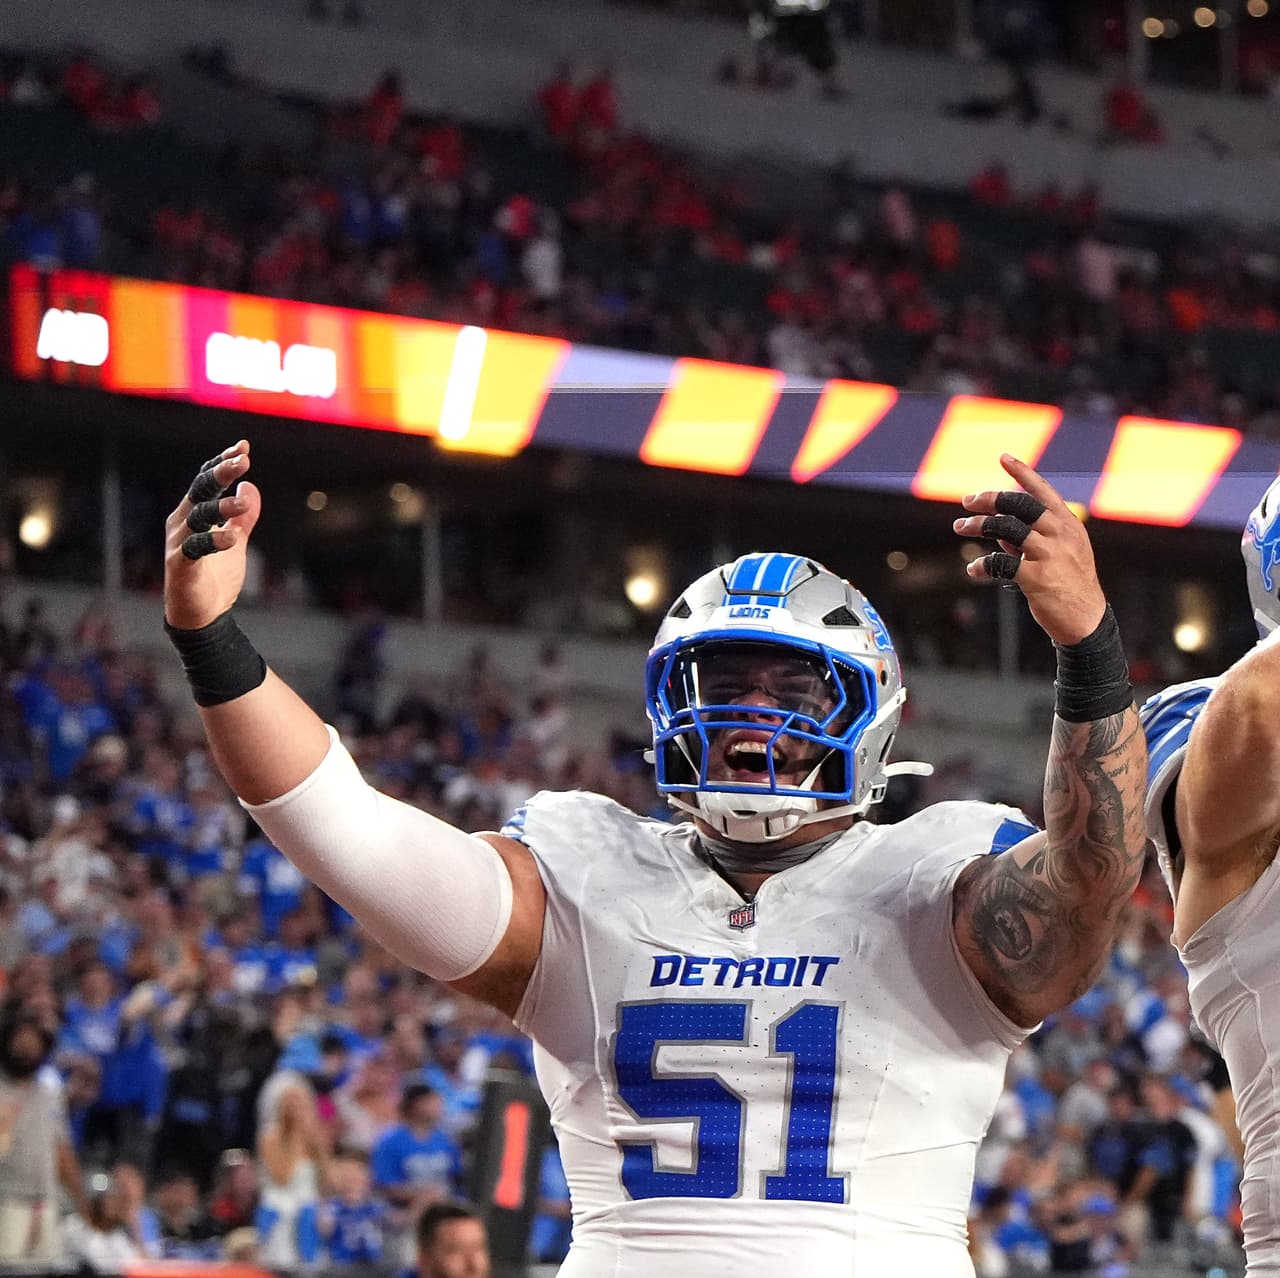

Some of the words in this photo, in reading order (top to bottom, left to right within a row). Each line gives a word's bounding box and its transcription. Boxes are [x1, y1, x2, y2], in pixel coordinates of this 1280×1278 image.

[728, 605, 771, 620] LIONS
[649, 954, 841, 989] DETROIT
[608, 999, 851, 1204] 51
